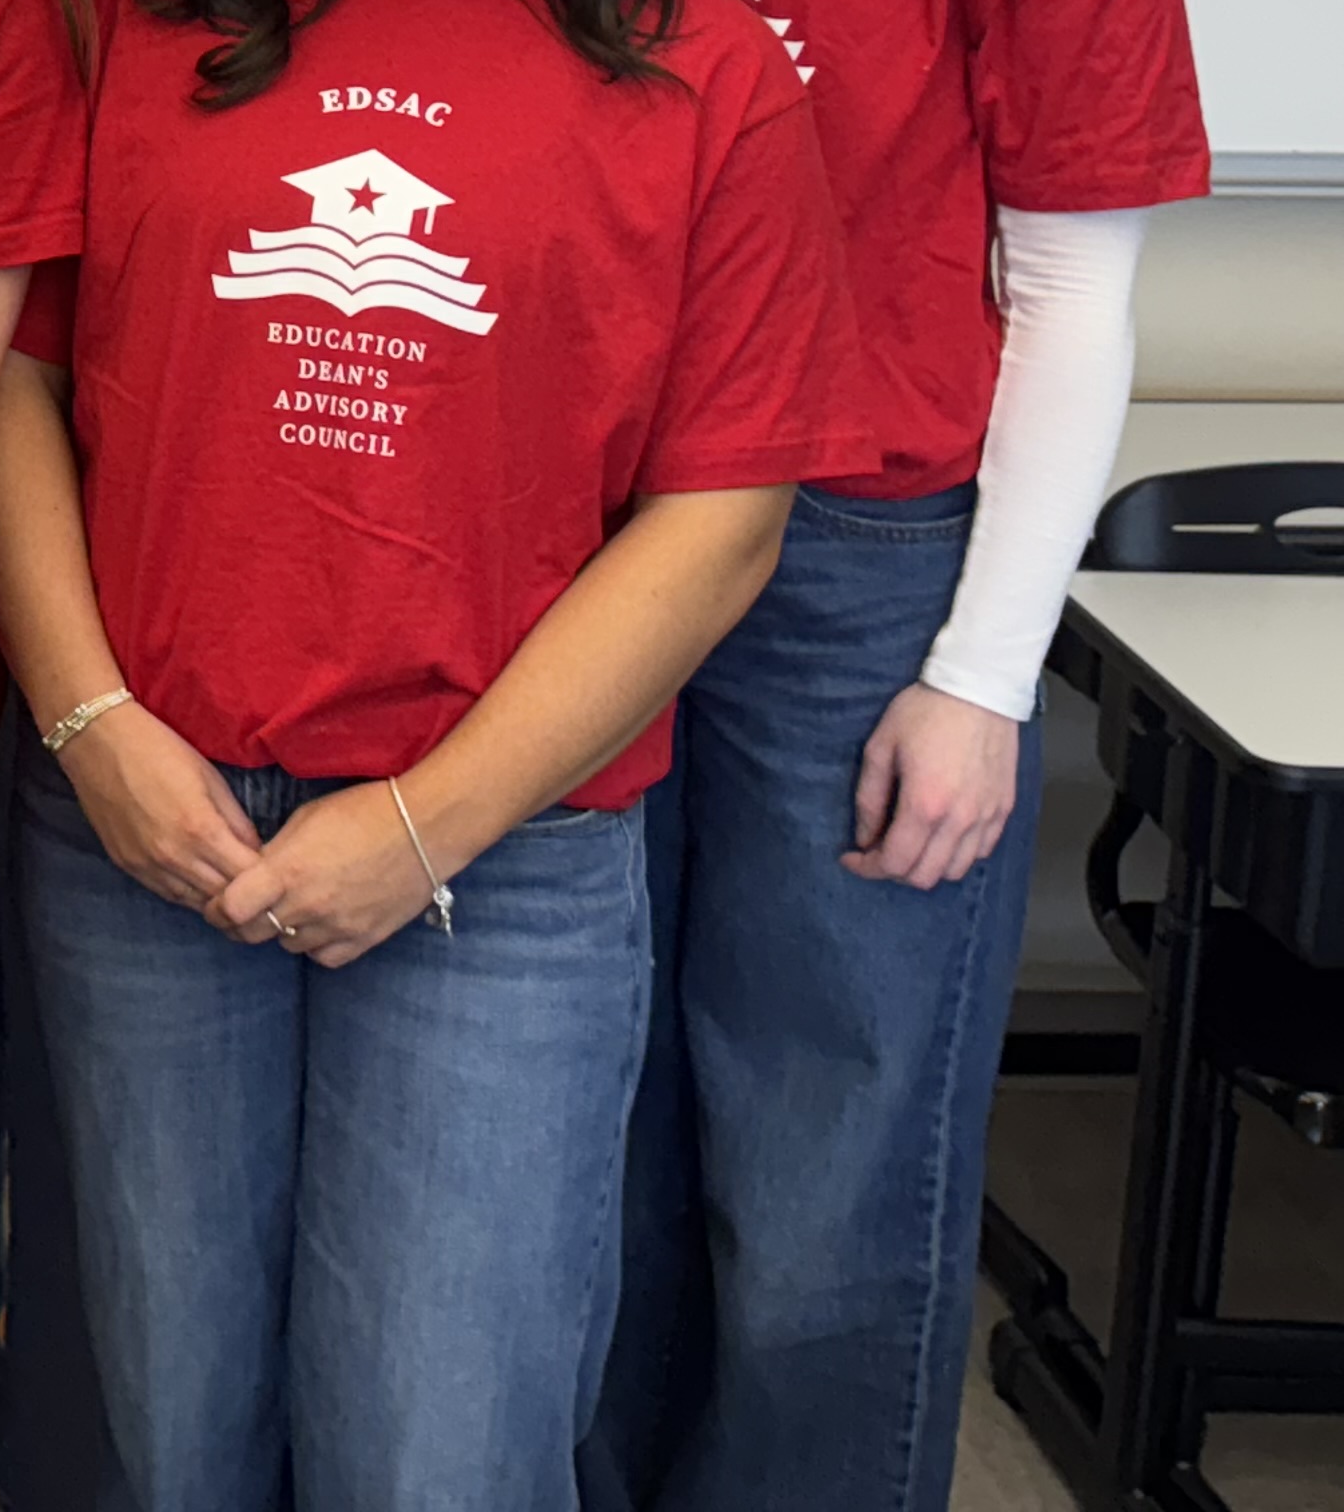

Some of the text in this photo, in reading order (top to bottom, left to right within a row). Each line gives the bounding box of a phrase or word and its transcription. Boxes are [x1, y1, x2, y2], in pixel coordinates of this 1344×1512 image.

[319, 87, 452, 127] EDSAC
[267, 322, 426, 364] EDUCATION
[298, 358, 389, 389] DEAN'S
[273, 390, 408, 426] ADVISORY
[280, 421, 397, 457] COUNCIL
